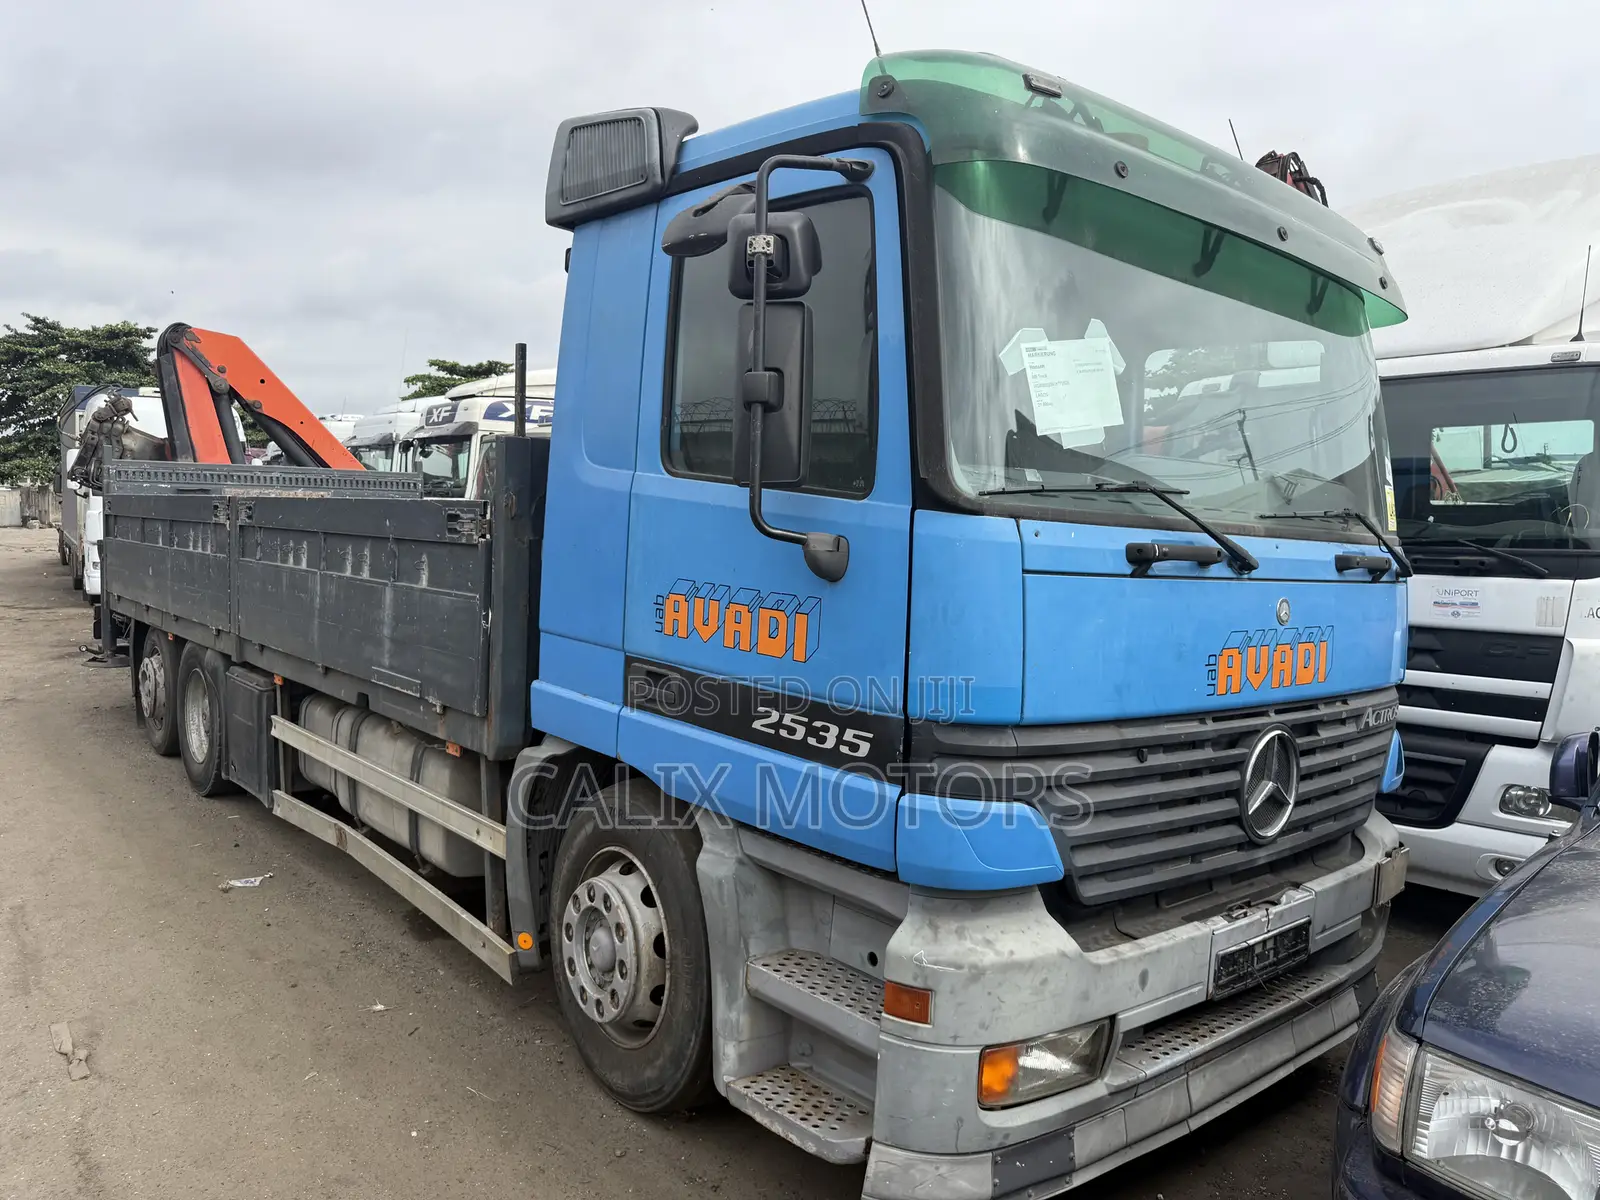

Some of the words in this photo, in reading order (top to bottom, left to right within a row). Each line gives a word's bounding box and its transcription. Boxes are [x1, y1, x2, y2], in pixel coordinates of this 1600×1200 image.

[428, 405, 452, 424] XF
[664, 590, 811, 663] AVADI
[1216, 637, 1330, 697] AVADI
[751, 706, 874, 760] 2535
